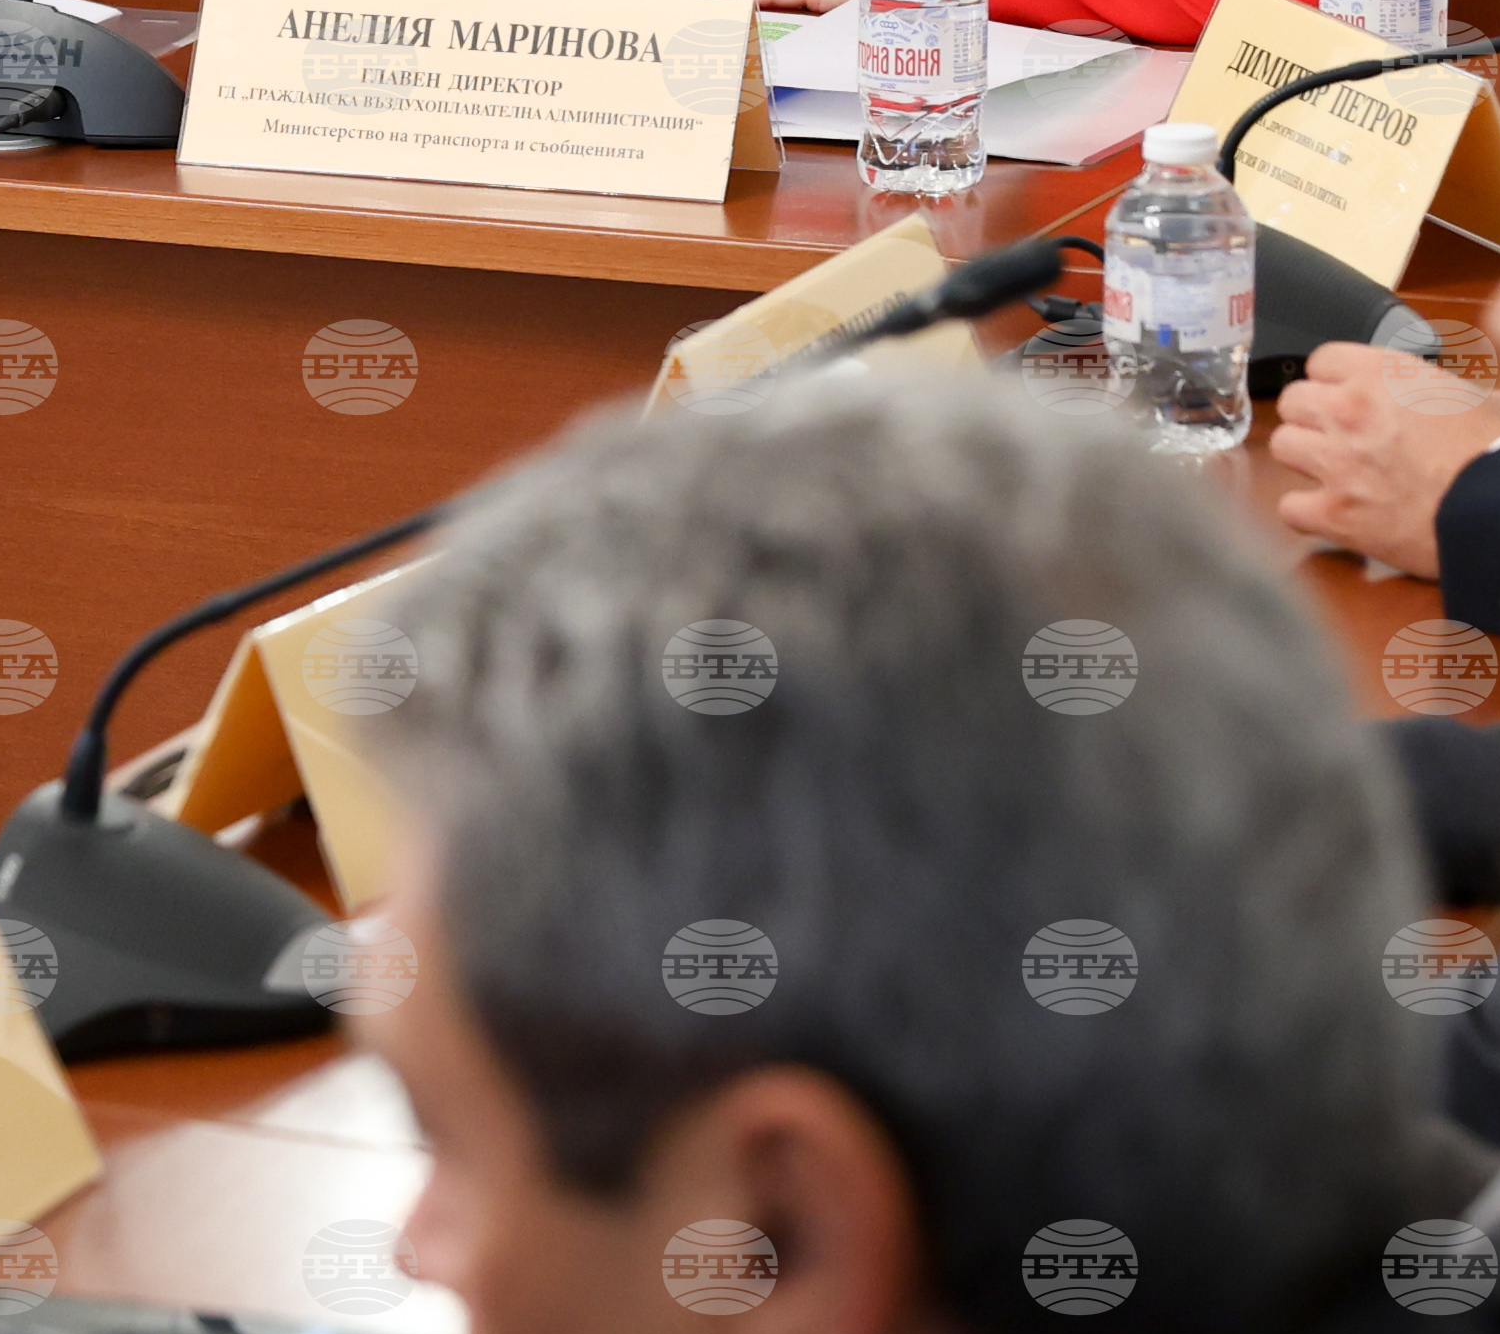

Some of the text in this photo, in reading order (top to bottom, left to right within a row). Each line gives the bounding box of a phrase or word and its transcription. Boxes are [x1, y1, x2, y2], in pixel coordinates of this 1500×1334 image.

[276, 9, 662, 63] АНЕЛИЯ МАРИНОВА
[361, 67, 563, 96] ГЛАВЕН ДИРЕКТОР
[218, 85, 237, 100] ГД
[363, 96, 542, 120] ВЪЗДУХОПЛАВАТЕЛНА
[1328, 84, 1418, 146] ПЕТРОВ
[263, 118, 644, 159] Министерство на транспорта и съобщенията
